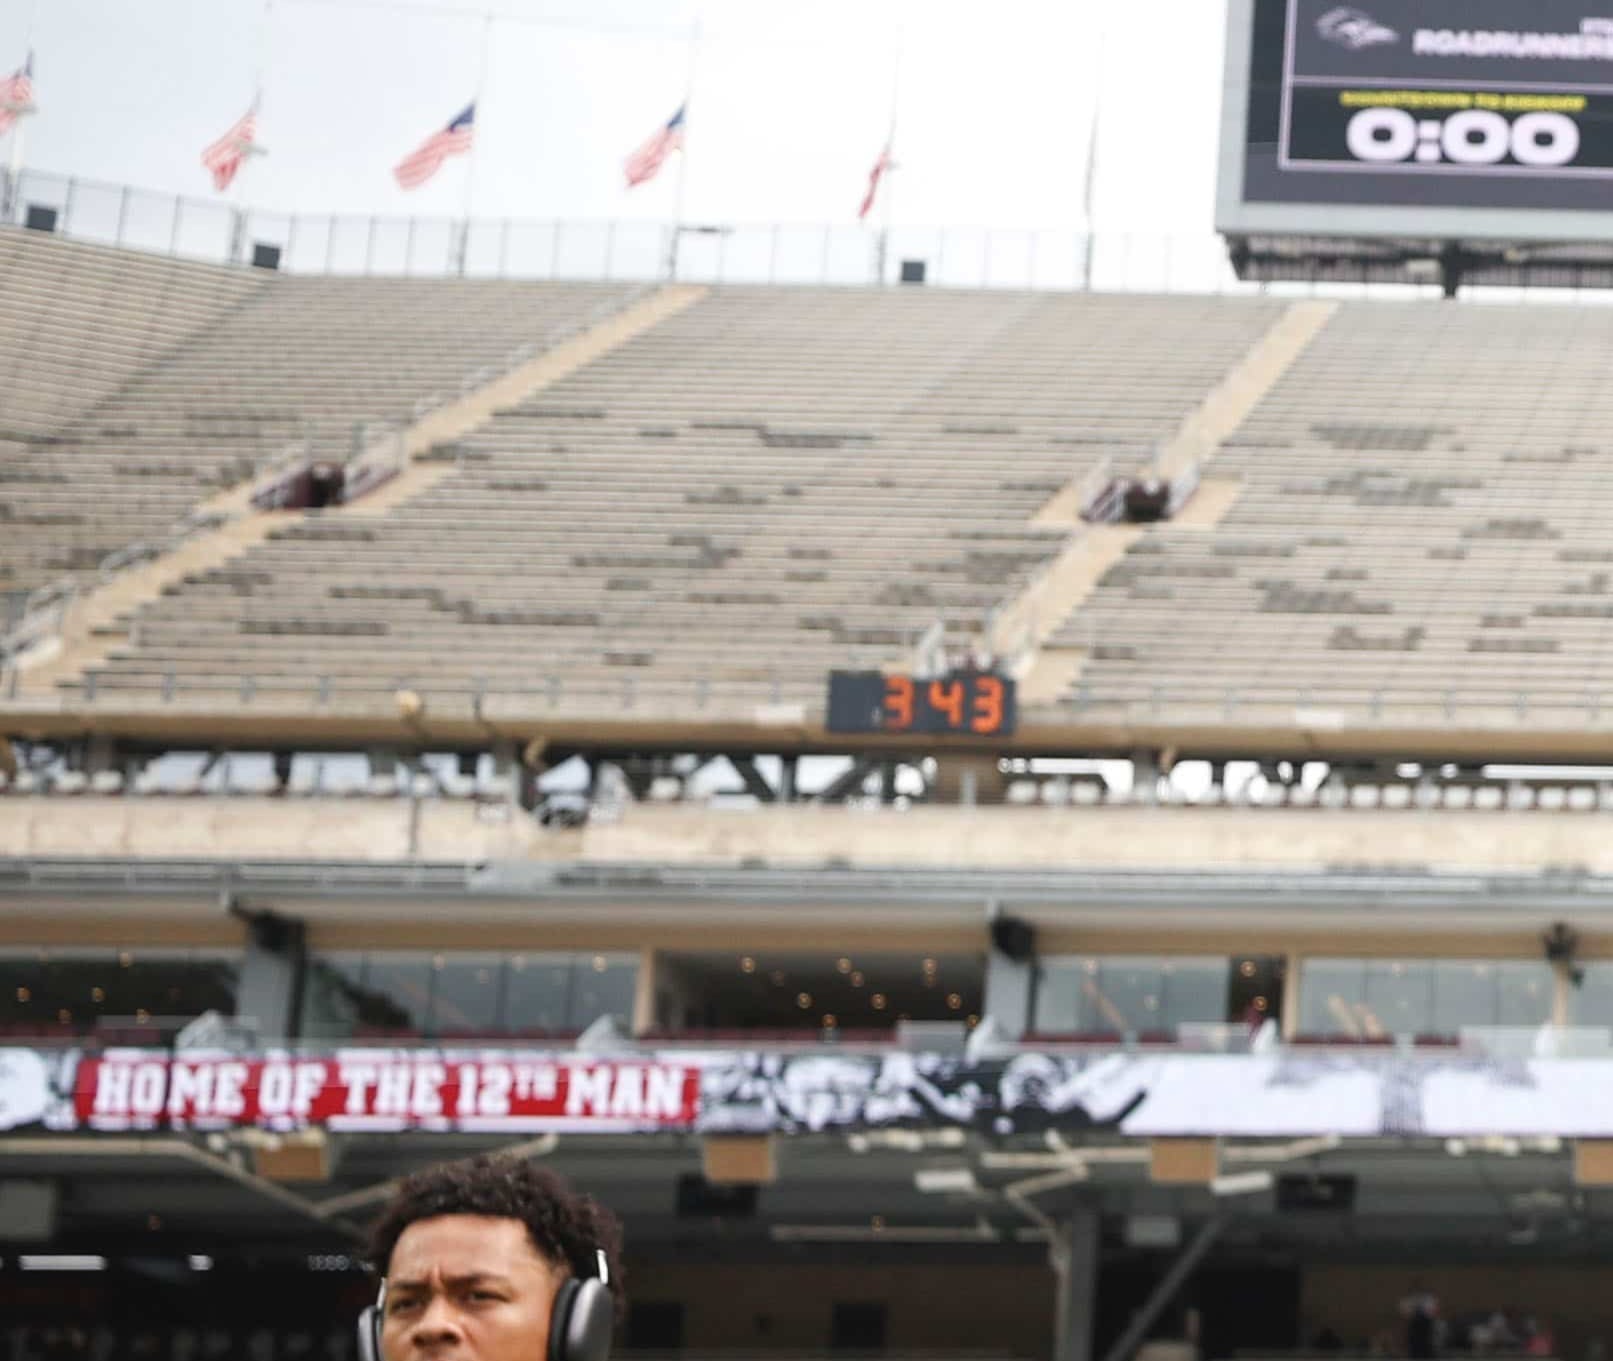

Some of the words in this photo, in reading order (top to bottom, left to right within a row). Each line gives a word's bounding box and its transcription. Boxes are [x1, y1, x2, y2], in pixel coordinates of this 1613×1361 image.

[1346, 107, 1580, 166] 0:00
[95, 1062, 247, 1116] HOME
[258, 1062, 327, 1116] OF
[339, 1062, 446, 1116] THE
[565, 1063, 685, 1119] MAN
